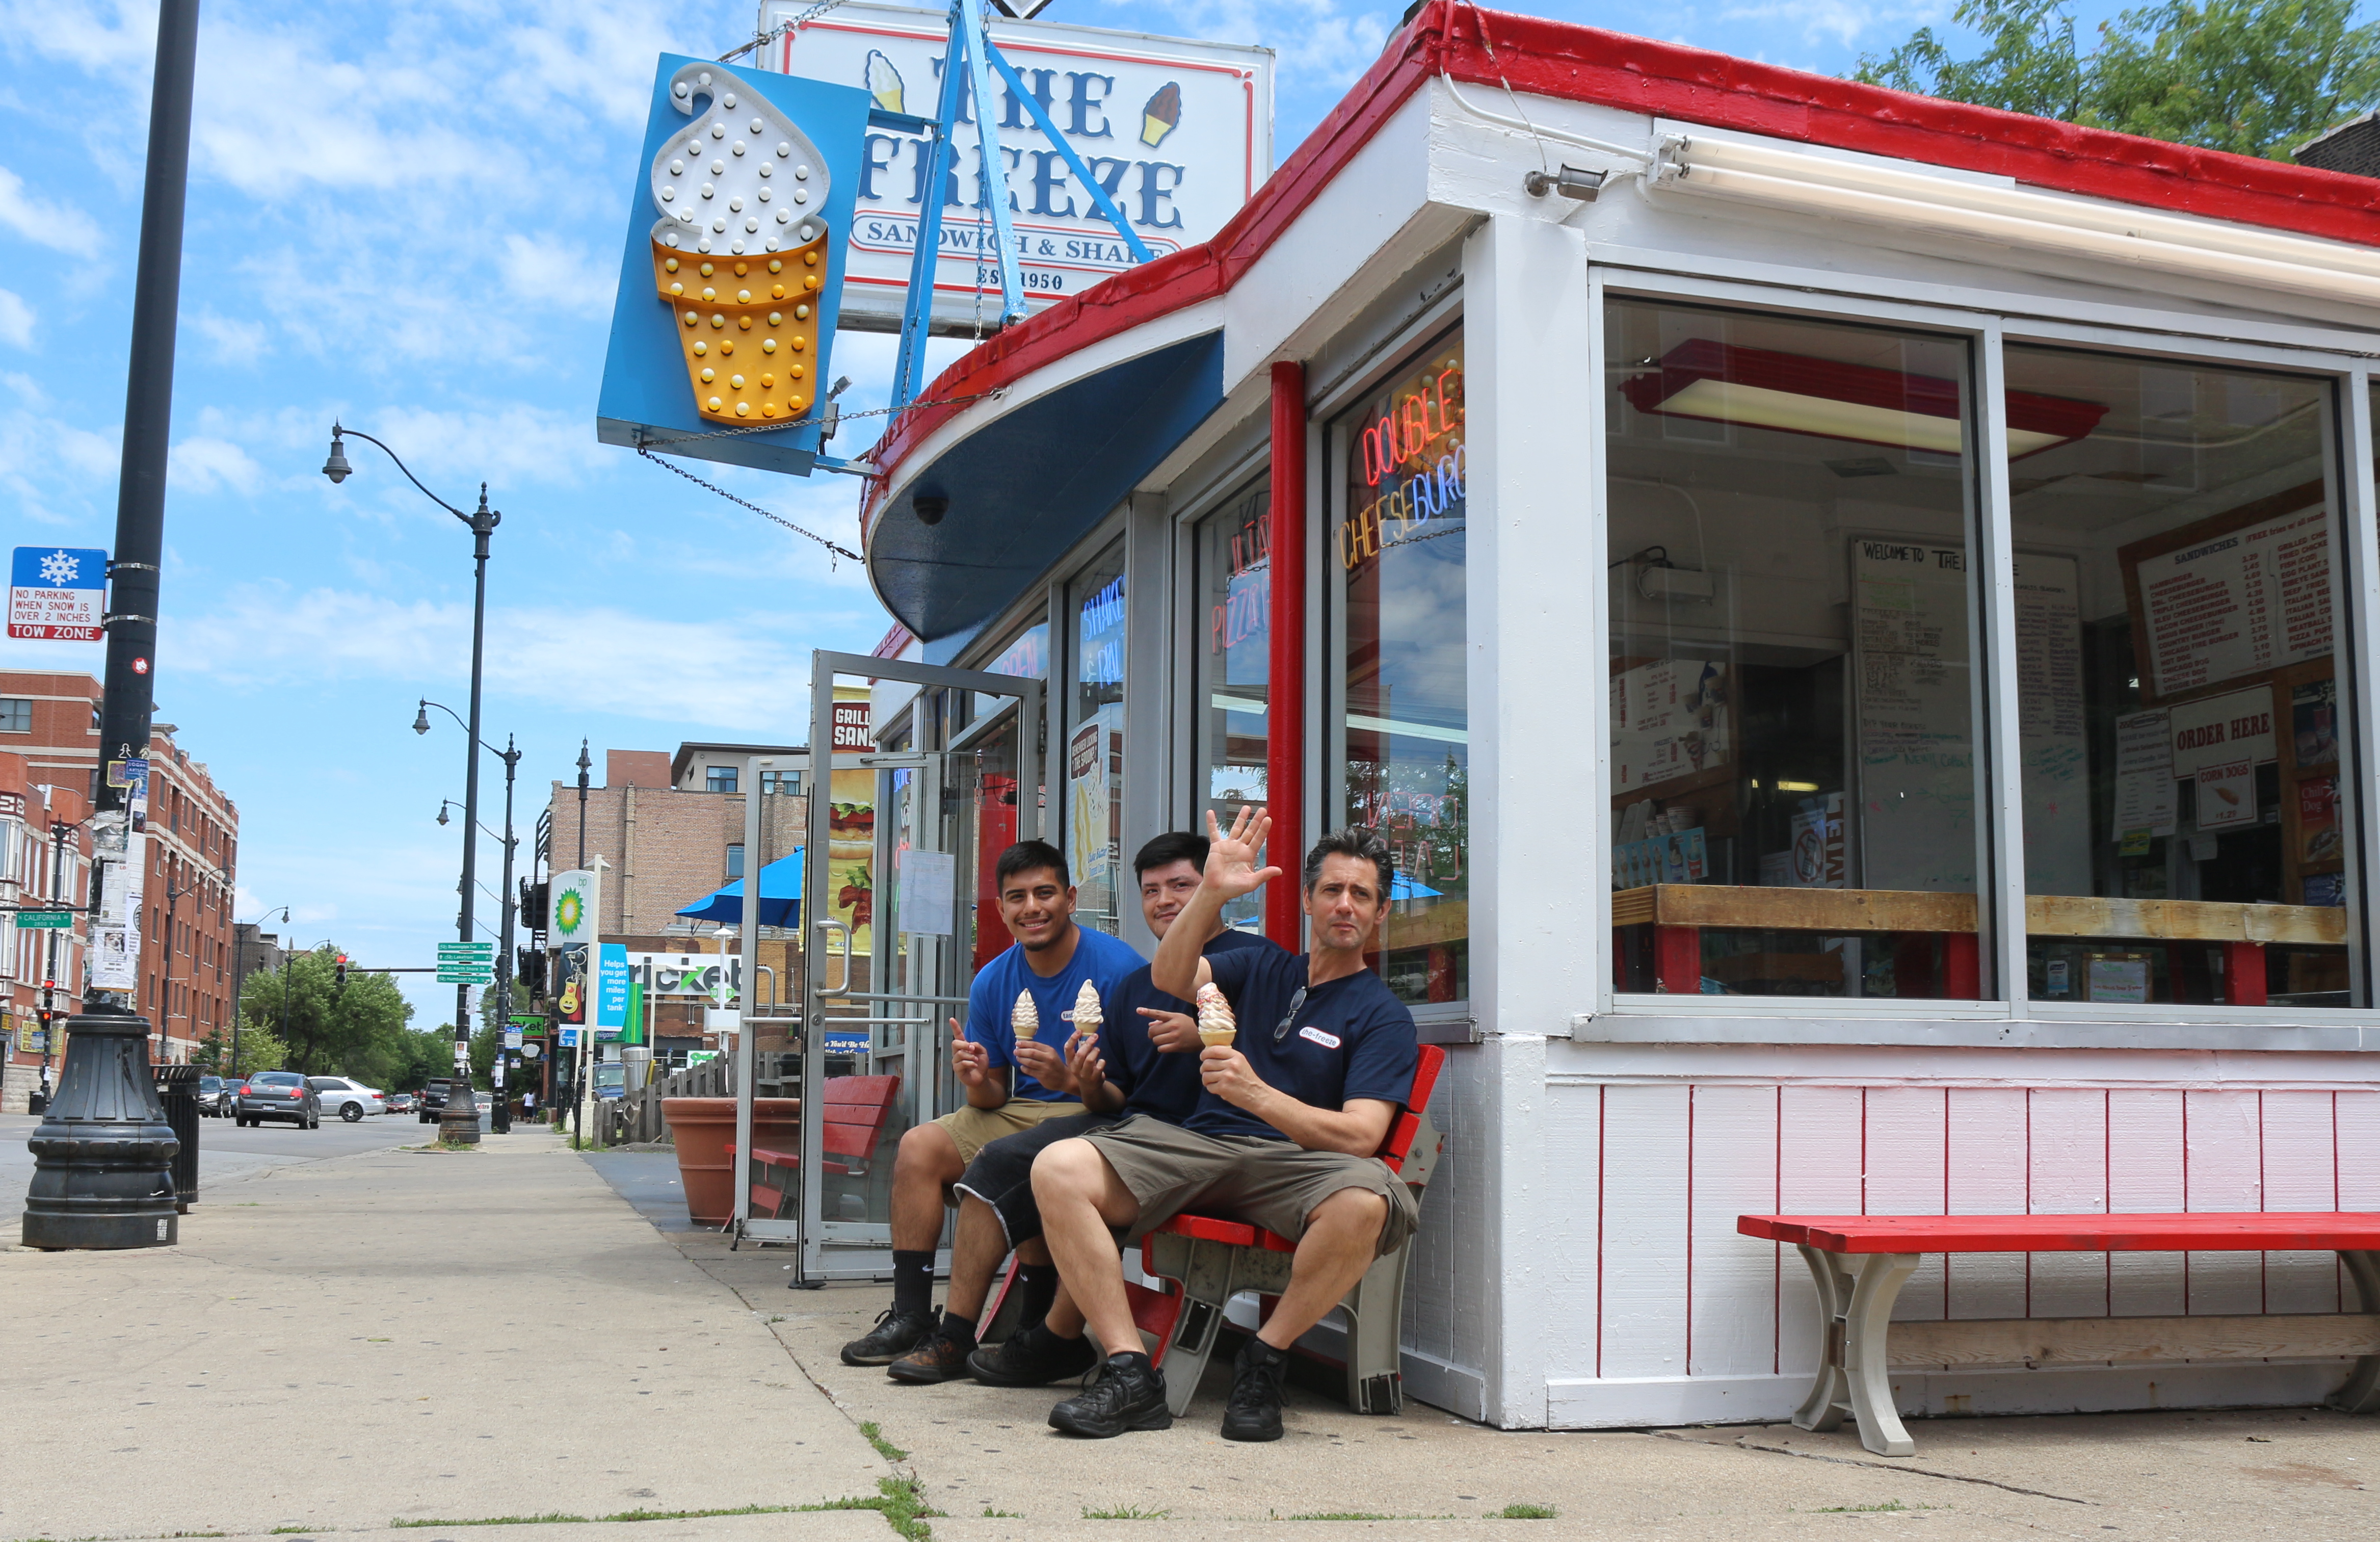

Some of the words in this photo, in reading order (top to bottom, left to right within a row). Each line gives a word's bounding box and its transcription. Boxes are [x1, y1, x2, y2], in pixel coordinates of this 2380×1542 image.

[930, 55, 1116, 140] THE
[857, 132, 1186, 229] FREEZE
[1038, 239, 1056, 256] &
[1363, 368, 1466, 486] DOUBLE
[2174, 537, 2239, 565] SANDWICHES
[2278, 537, 2308, 552] GRILLED
[1863, 542, 1909, 561] WELCOME
[1910, 547, 1924, 563] TO
[1931, 551, 1961, 570] THE
[2279, 549, 2300, 561] FRIED
[2243, 562, 2260, 571] 3.45
[2280, 559, 2297, 570] FISH
[2281, 569, 2297, 579] EGG
[2298, 561, 2322, 573] PLANT
[2149, 572, 2193, 590] HAMBURGER
[2151, 578, 2206, 599] CHEESEBURGER
[2282, 574, 2309, 588] RIBEYE
[2283, 586, 2302, 597] DEEP
[2306, 579, 2327, 590] FRIED
[16, 590, 29, 599] NO
[35, 590, 75, 601] PARKING
[2168, 581, 2226, 603] CHEESEBURGER
[2284, 592, 2313, 607] ITALIAN
[15, 600, 42, 611] WHEN
[48, 602, 75, 611] SNOW
[80, 603, 89, 612] IS
[2153, 603, 2175, 616] TRIPLE
[2176, 589, 2229, 610] CHEESEBURGER
[2154, 613, 2172, 624] BLEU
[2173, 597, 2231, 618] CHEESEBURGER
[2247, 598, 2264, 607] 4.50
[2285, 602, 2314, 615] ITALIAN
[14, 611, 39, 620] OVER
[44, 612, 51, 621] 2
[57, 613, 91, 623] INCHES
[2155, 620, 2178, 633] BACON
[2180, 604, 2239, 626] CHEESEBURGER
[2286, 611, 2315, 624] ITALIAN
[2287, 617, 2325, 633] MEATBALL
[13, 625, 45, 638] TOW
[54, 626, 94, 639] ZONE
[2157, 630, 2178, 641] ANGUS
[2179, 623, 2204, 637] BURGER
[2158, 636, 2190, 649] COUNTRY
[2192, 627, 2222, 641] BURGER
[2288, 632, 2310, 643] PIZZA
[2159, 645, 2190, 658] CHICAGO
[2191, 640, 2207, 650] FIRE
[2209, 632, 2239, 645] BURGER
[2289, 637, 2322, 651] SPINACH
[2161, 657, 2175, 666] HOT
[2176, 653, 2191, 663] DOG
[2162, 662, 2192, 674] CHICAGO
[2194, 658, 2210, 667] DOG
[2163, 671, 2190, 683] CHEESE
[2191, 667, 2207, 676] DOG
[2163, 680, 2190, 692] VEGGIE
[2191, 676, 2207, 685] DOG
[2177, 722, 2225, 751] ORDER
[2230, 713, 2269, 741] HERE
[2200, 770, 2224, 783] CORN
[2226, 764, 2249, 777] DOGS
[2302, 785, 2324, 799] Chili
[2303, 800, 2322, 813] Dog
[578, 877, 587, 888] bp
[2306, 876, 2331, 887] Grilled
[628, 956, 742, 991] ricket
[1302, 1029, 1336, 1046] the-freeze
